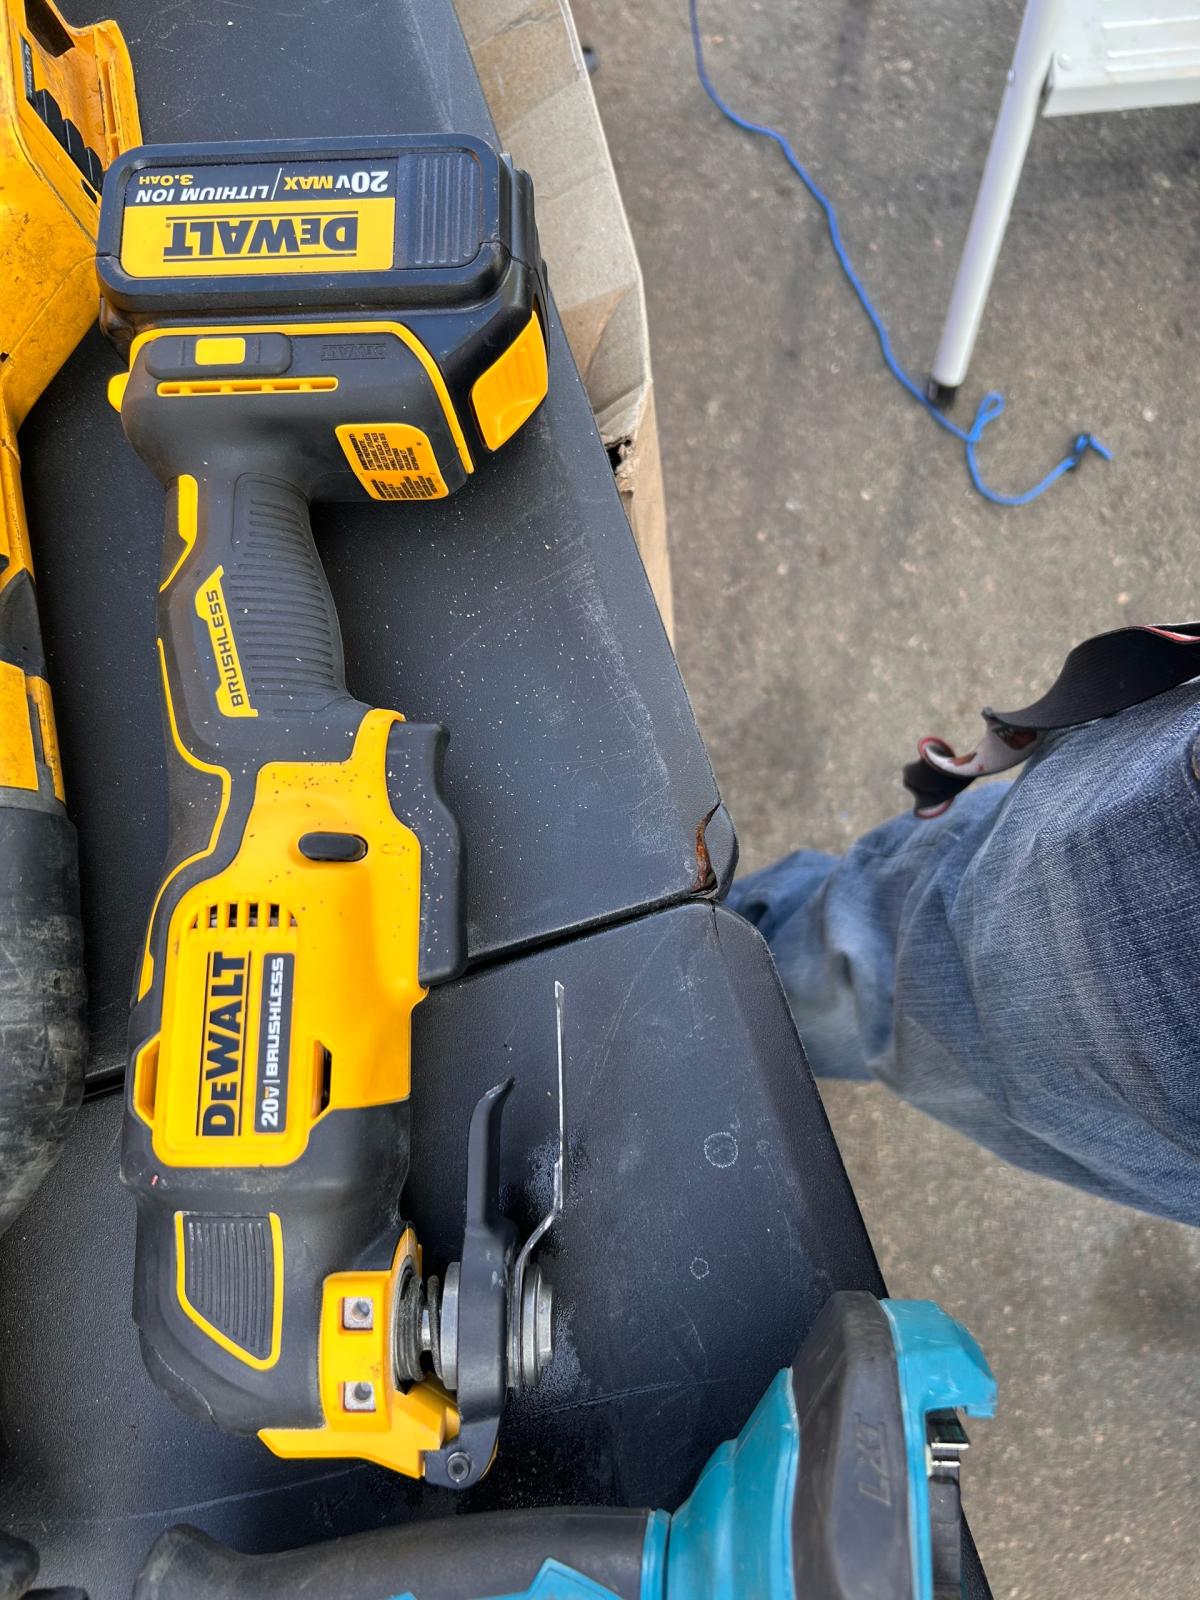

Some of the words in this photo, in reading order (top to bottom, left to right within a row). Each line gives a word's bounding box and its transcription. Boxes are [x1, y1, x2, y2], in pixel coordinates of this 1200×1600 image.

[283, 175, 333, 191] MAX
[135, 189, 174, 203] ION
[180, 185, 270, 202] LITHIUM
[206, 589, 244, 707] BRUSHLESS
[265, 957, 285, 1077] BRUSHLESS
